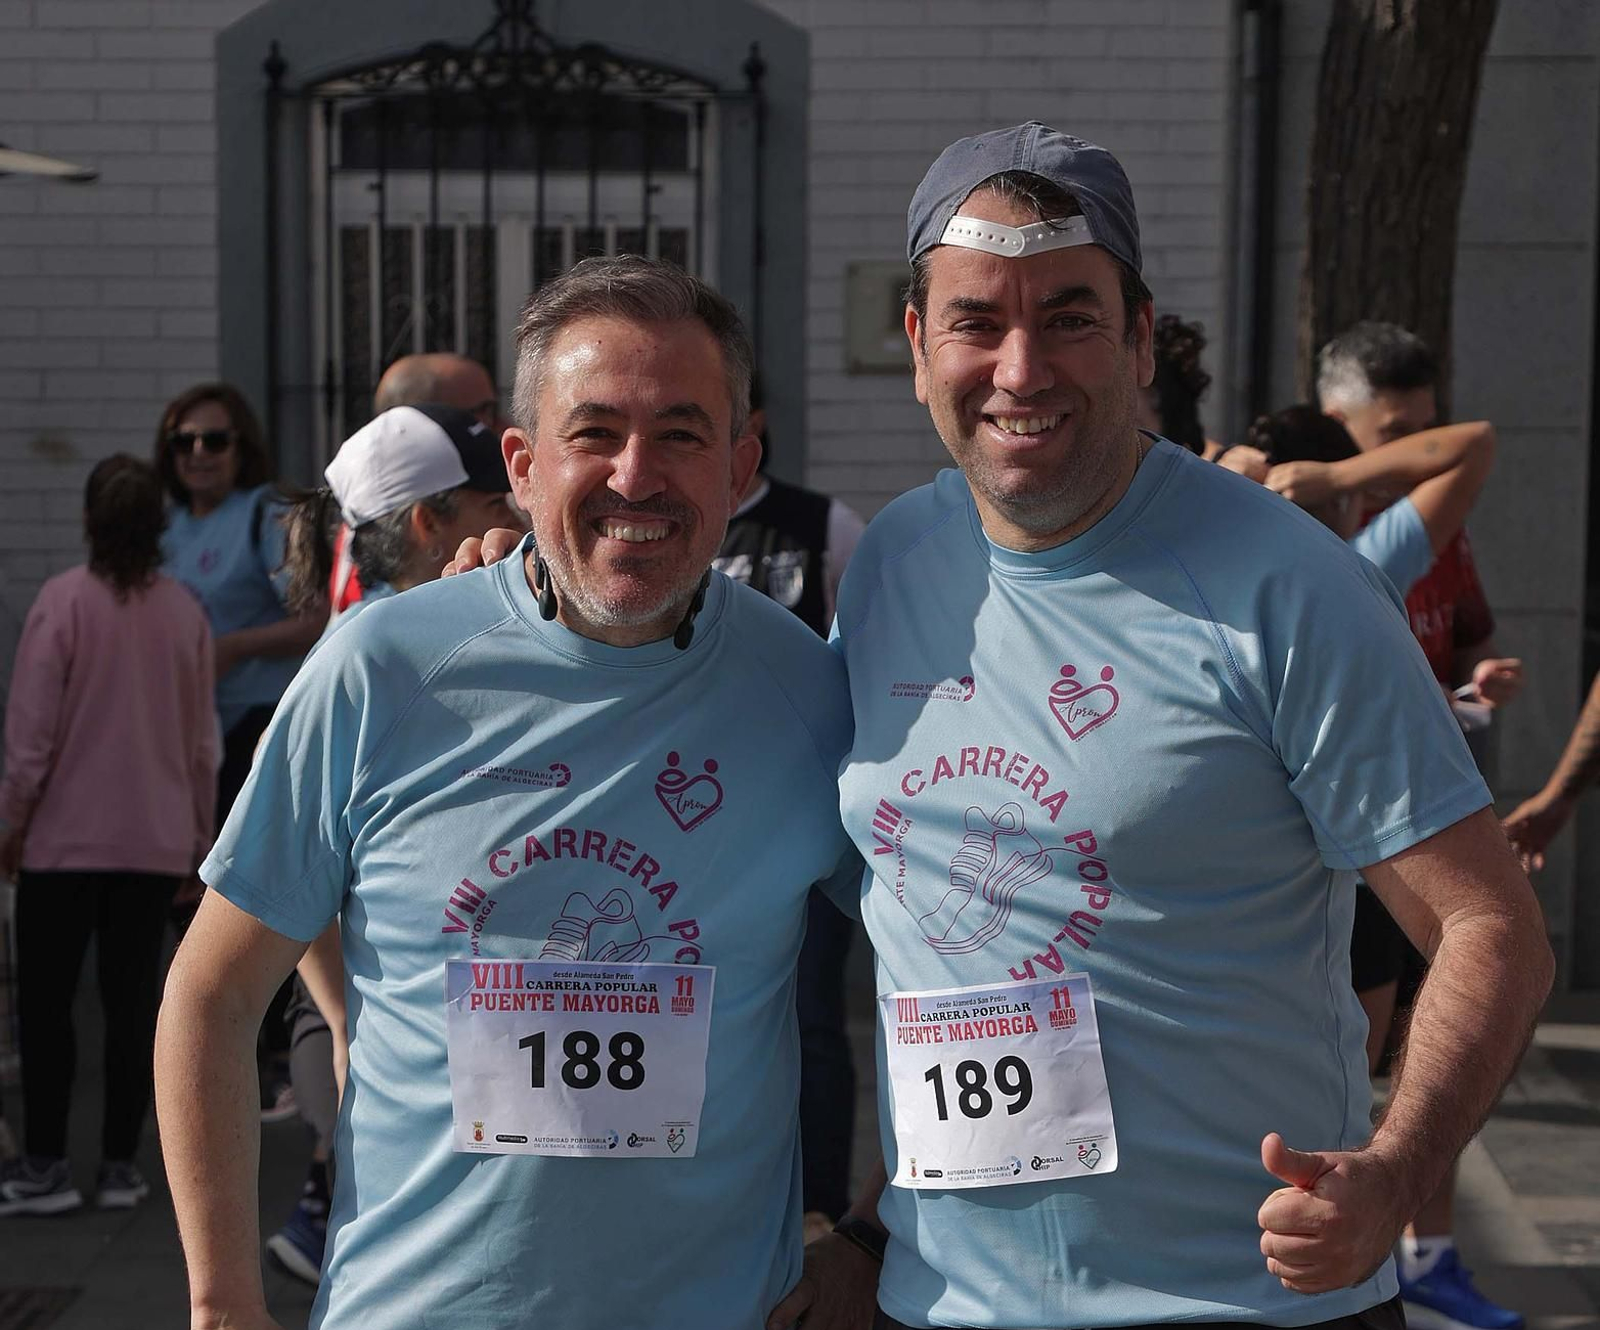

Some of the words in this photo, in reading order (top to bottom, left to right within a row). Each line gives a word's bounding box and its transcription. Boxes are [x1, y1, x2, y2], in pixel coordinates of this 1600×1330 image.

[508, 768, 554, 780] PORTUARIA
[873, 798, 902, 856] VIII
[901, 746, 1069, 824] CARRERA
[442, 878, 487, 933] VIII
[488, 828, 679, 912] CARRERA
[471, 900, 497, 956] MAYORGA
[470, 963, 524, 990] VIII
[526, 980, 591, 991] CARRERA
[595, 982, 657, 993] POPULAR
[616, 972, 634, 980] Pedro
[675, 975, 693, 996] 11
[470, 993, 555, 1012] PUENTE
[563, 993, 660, 1014] MAYORGA
[671, 996, 694, 1007] MAYO
[937, 1001, 951, 1009] desde
[953, 998, 977, 1008] Alameda
[978, 997, 988, 1005] San
[1050, 986, 1071, 1010] 11
[896, 998, 920, 1023] VIII
[920, 1009, 968, 1023] CARRERA
[973, 1002, 1032, 1017] POPULAR
[1049, 1008, 1076, 1021] MAYO
[897, 1021, 944, 1045] PUENTE
[949, 1014, 1038, 1042] MAYORGA
[518, 1030, 646, 1090] 188
[924, 1055, 1033, 1121] 189
